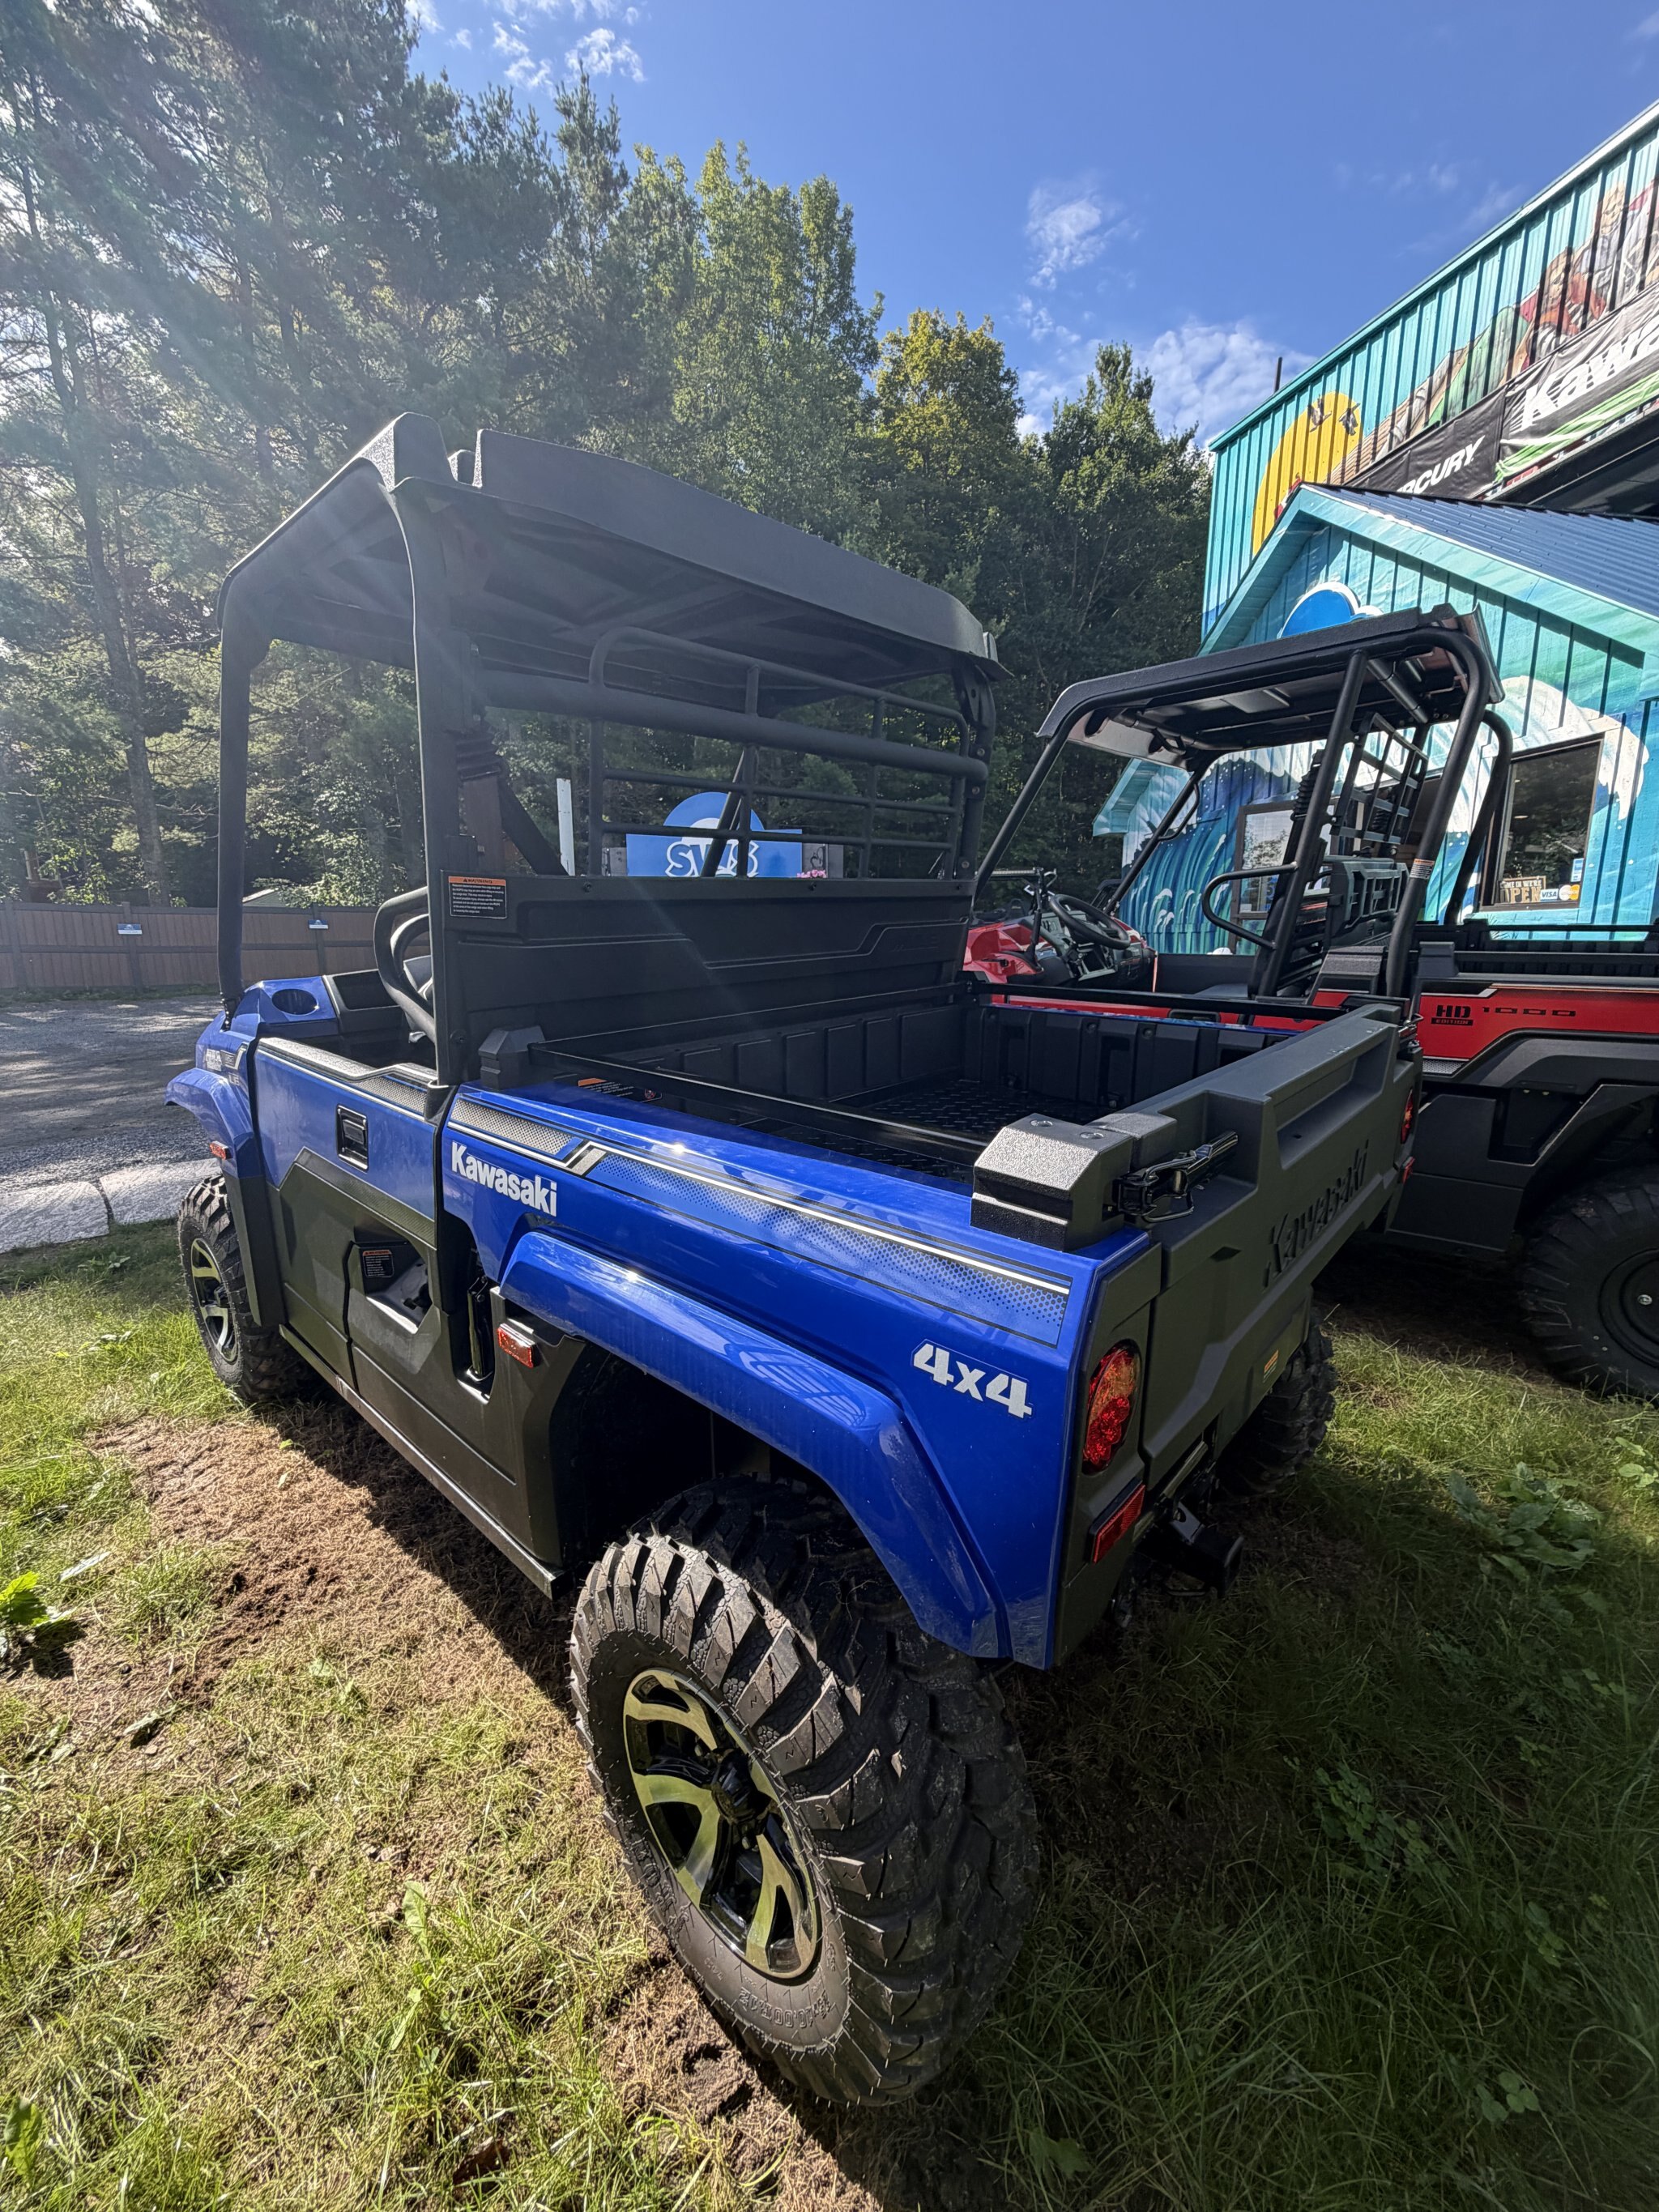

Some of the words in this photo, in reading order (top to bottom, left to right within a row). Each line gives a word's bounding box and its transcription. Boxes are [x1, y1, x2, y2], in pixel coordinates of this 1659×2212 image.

[1500, 887, 1542, 903] OPEN
[1436, 1005, 1471, 1018] HD
[1482, 1007, 1576, 1017] 1000
[451, 1141, 557, 1217] Kawasaki
[1262, 1139, 1368, 1289] Kawasaki
[914, 1343, 1032, 1419] 4x4
